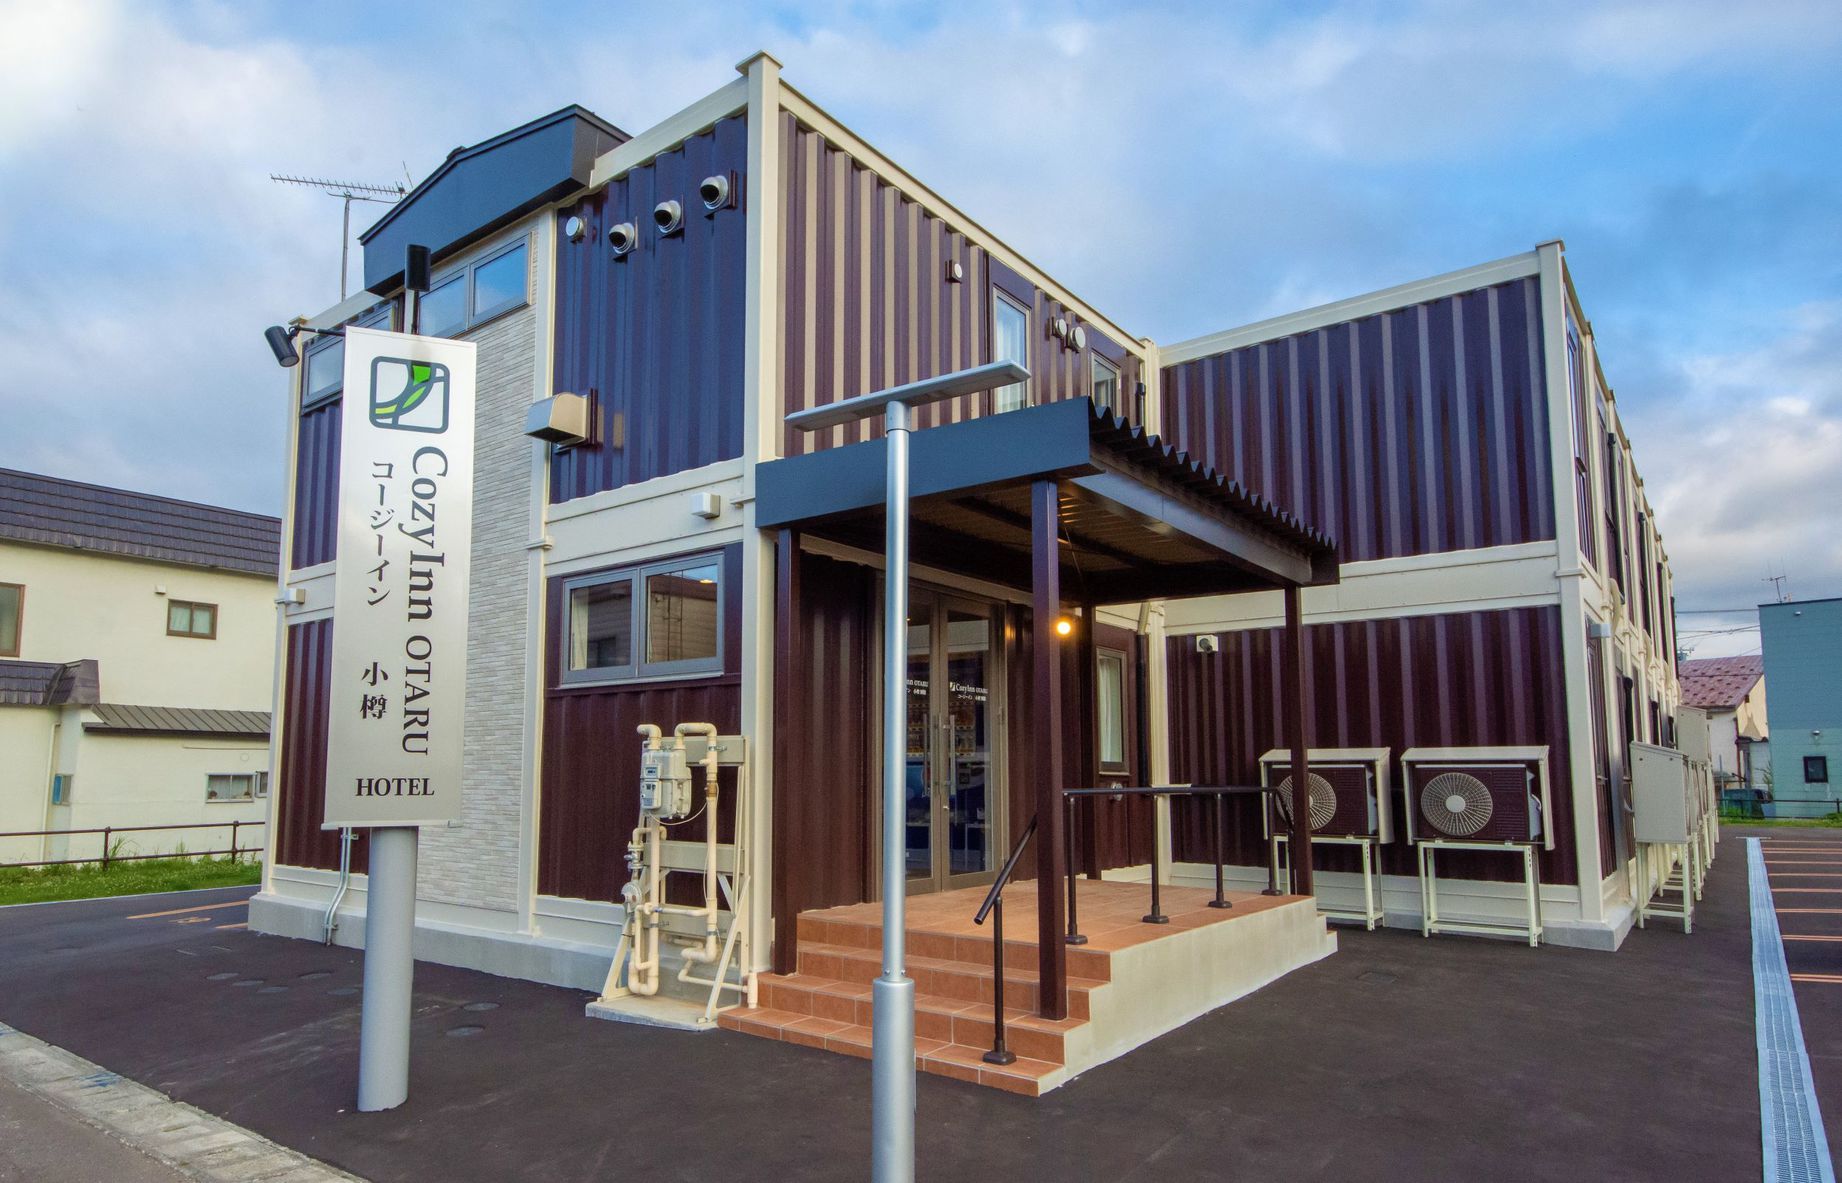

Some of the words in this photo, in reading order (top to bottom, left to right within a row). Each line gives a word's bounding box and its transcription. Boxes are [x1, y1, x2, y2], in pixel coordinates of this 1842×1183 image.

[366, 461, 395, 606] コージーイン
[360, 661, 388, 719] 小樽
[402, 635, 432, 756] OTARU
[355, 778, 435, 796] HOTEL
